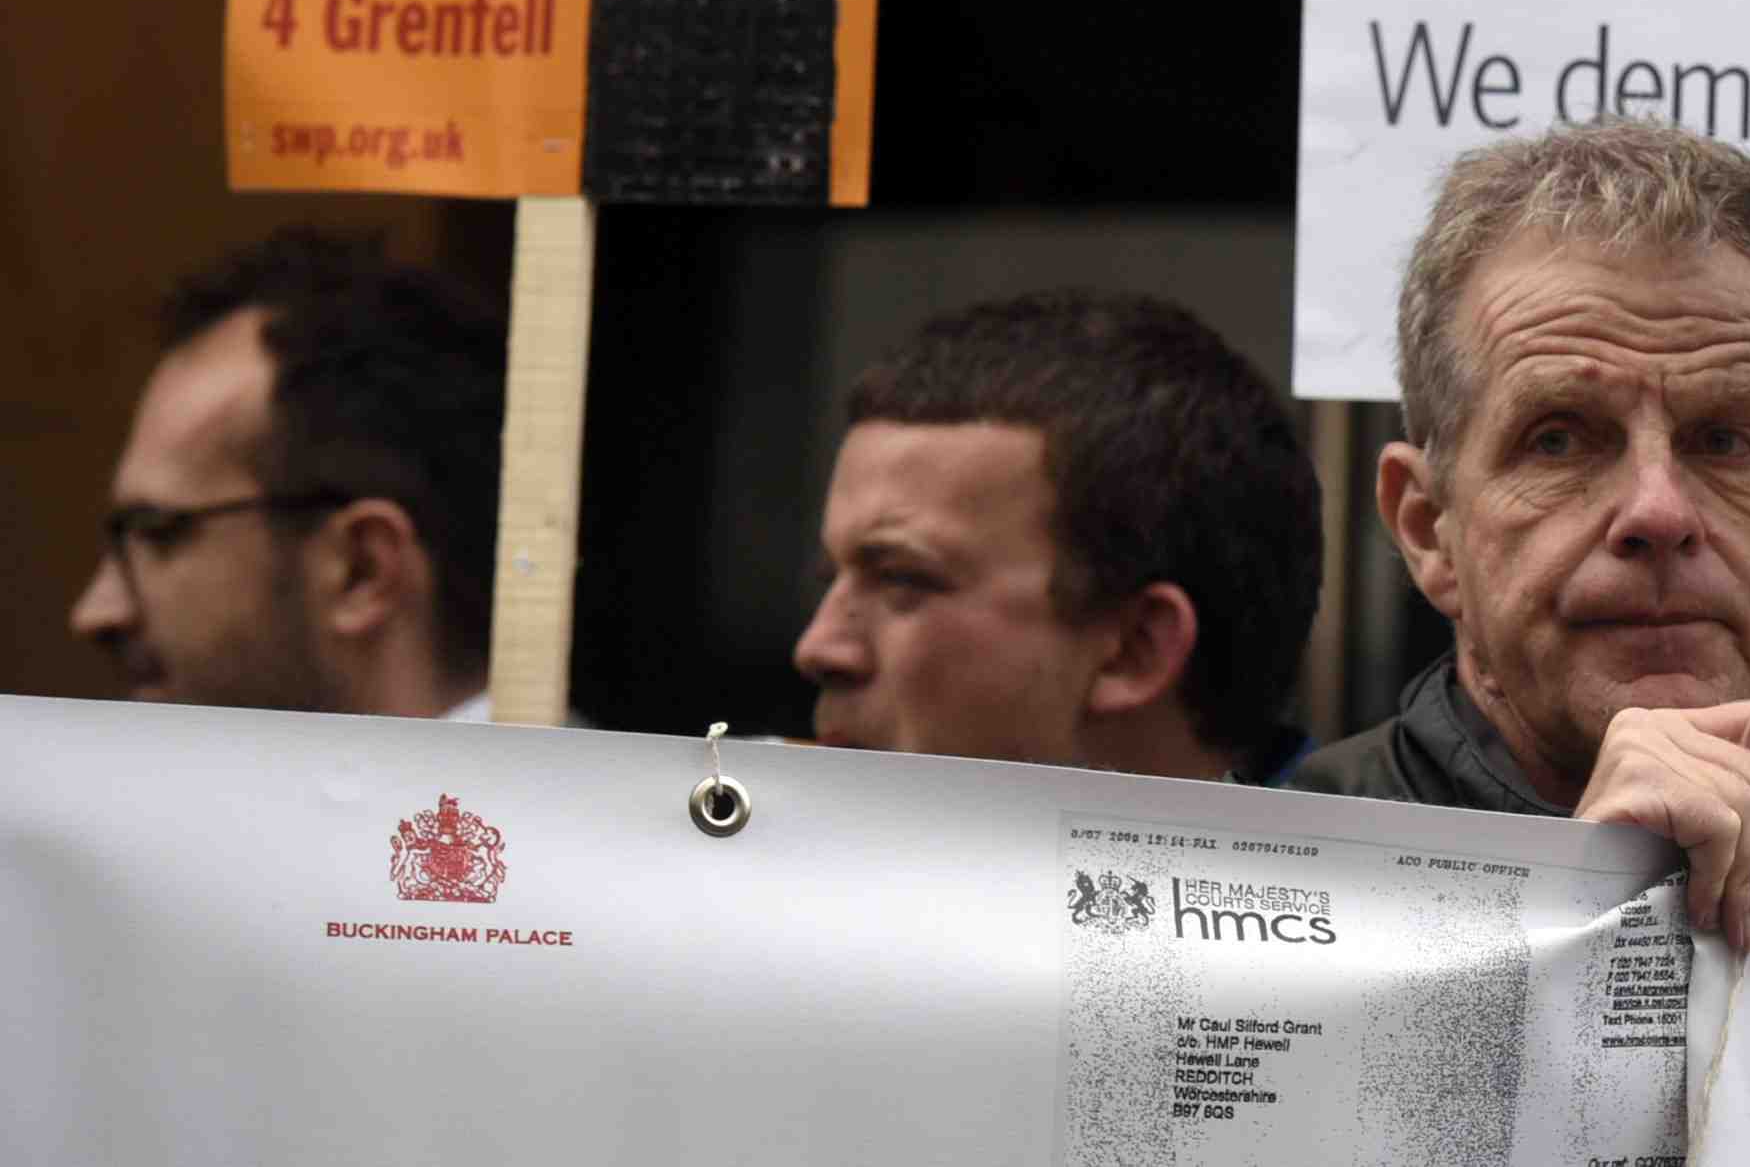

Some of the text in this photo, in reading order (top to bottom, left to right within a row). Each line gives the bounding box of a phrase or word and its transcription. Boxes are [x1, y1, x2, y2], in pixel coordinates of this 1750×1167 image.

[1370, 21, 1521, 129] We
[272, 120, 465, 165] swp.org.uk
[1185, 879, 1331, 905] HER MAJESTY'S
[1172, 876, 1337, 944] hmcs
[1185, 893, 1332, 915] COURTS SERVICE
[326, 922, 574, 946] BUCKINGHAM PALACE
[1177, 1017, 1195, 1031] Mr
[1283, 1020, 1323, 1035] Grant
[1206, 1036, 1240, 1050] HMP
[1244, 1037, 1291, 1052] Hewell
[1225, 1054, 1260, 1068] Lane
[1175, 1069, 1254, 1085] REDDITCH
